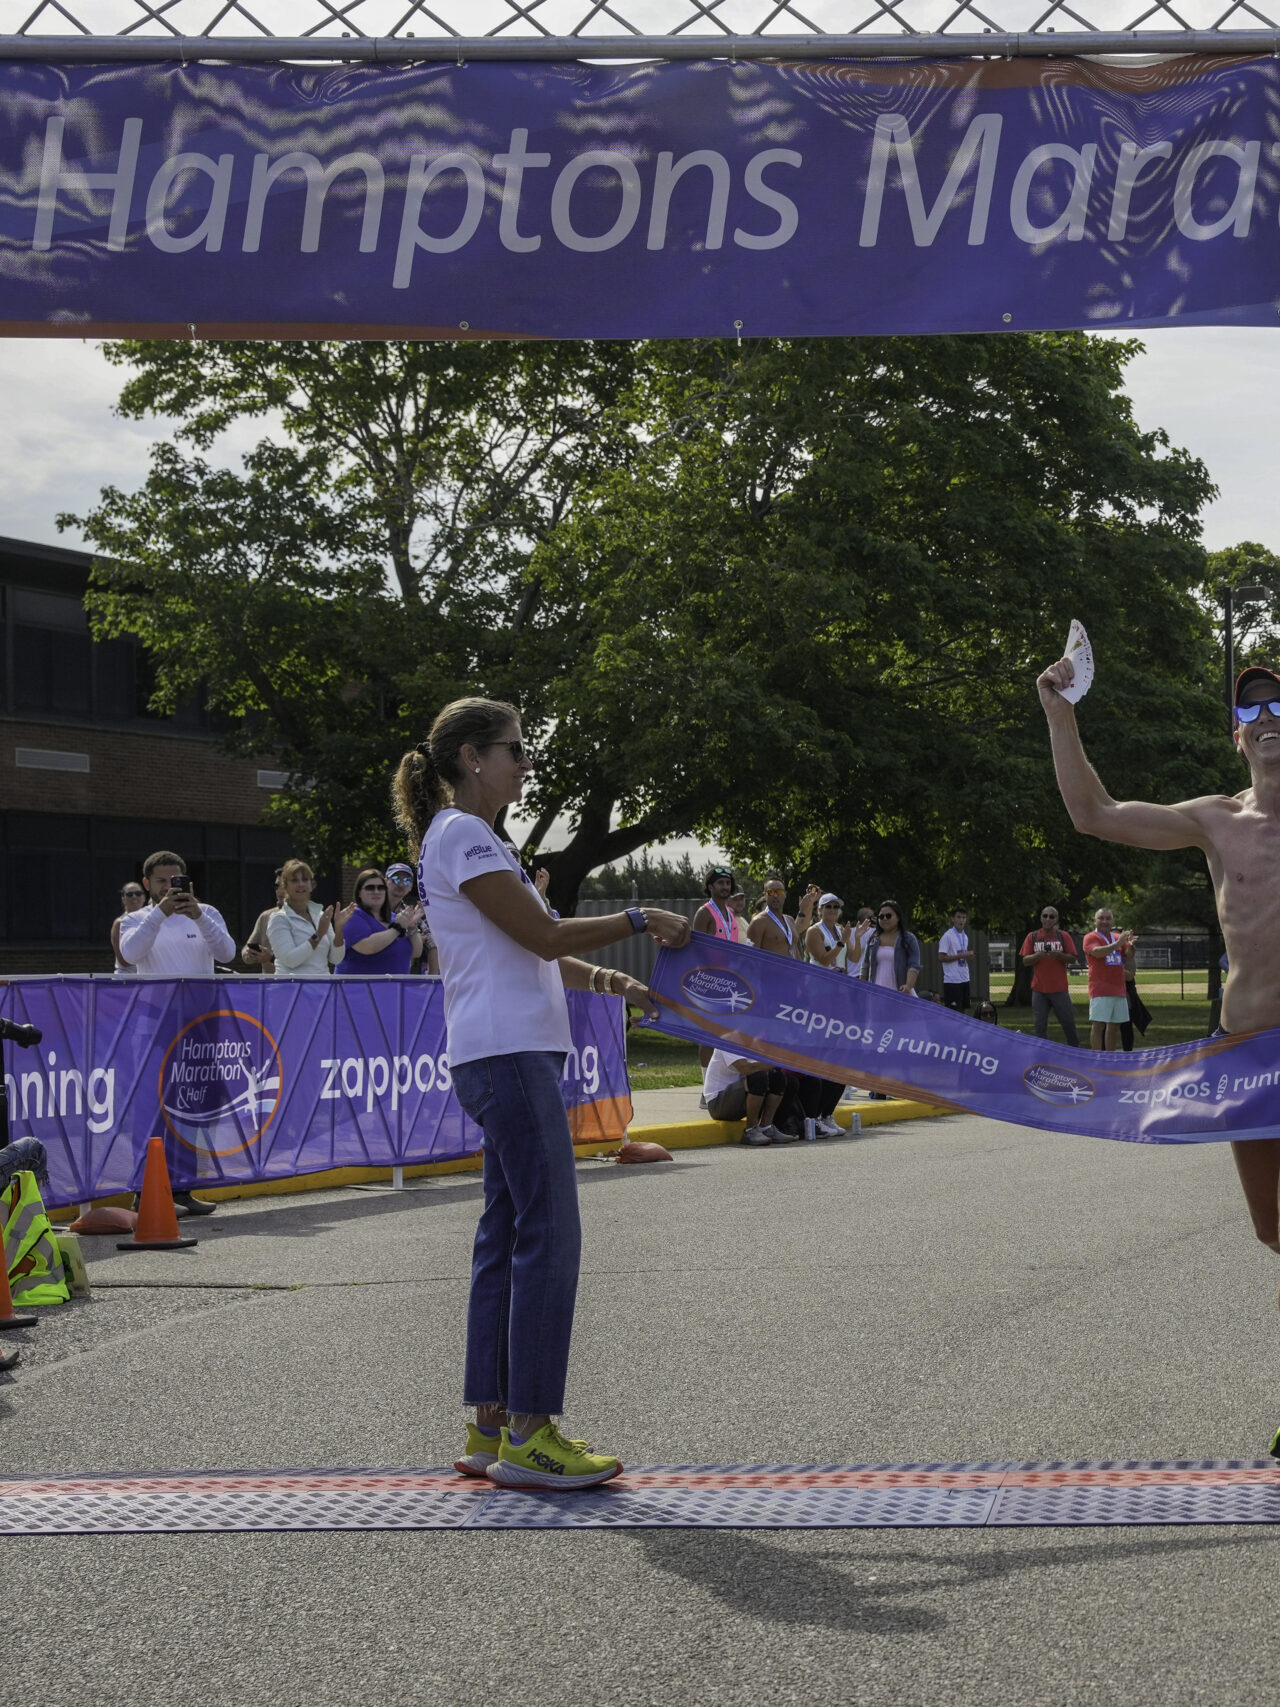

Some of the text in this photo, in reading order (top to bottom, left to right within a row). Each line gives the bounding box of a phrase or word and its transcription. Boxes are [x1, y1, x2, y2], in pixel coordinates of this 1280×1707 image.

[32, 115, 803, 289] Hamptons
[463, 844, 493, 861] jetBlue
[688, 975, 729, 993] Marathon
[695, 970, 737, 988] Hamptons
[181, 1038, 252, 1063] Hamptons
[775, 1003, 1000, 1076] zappos running
[170, 1060, 241, 1083] Marathon
[319, 1053, 451, 1113] zappos
[1029, 1070, 1070, 1088] Marathon
[1036, 1066, 1078, 1084] Hamptons
[4, 1050, 116, 1134] nning
[186, 1085, 208, 1105] Half
[1117, 1081, 1211, 1108] zappos
[526, 1448, 566, 1476] HOKA
